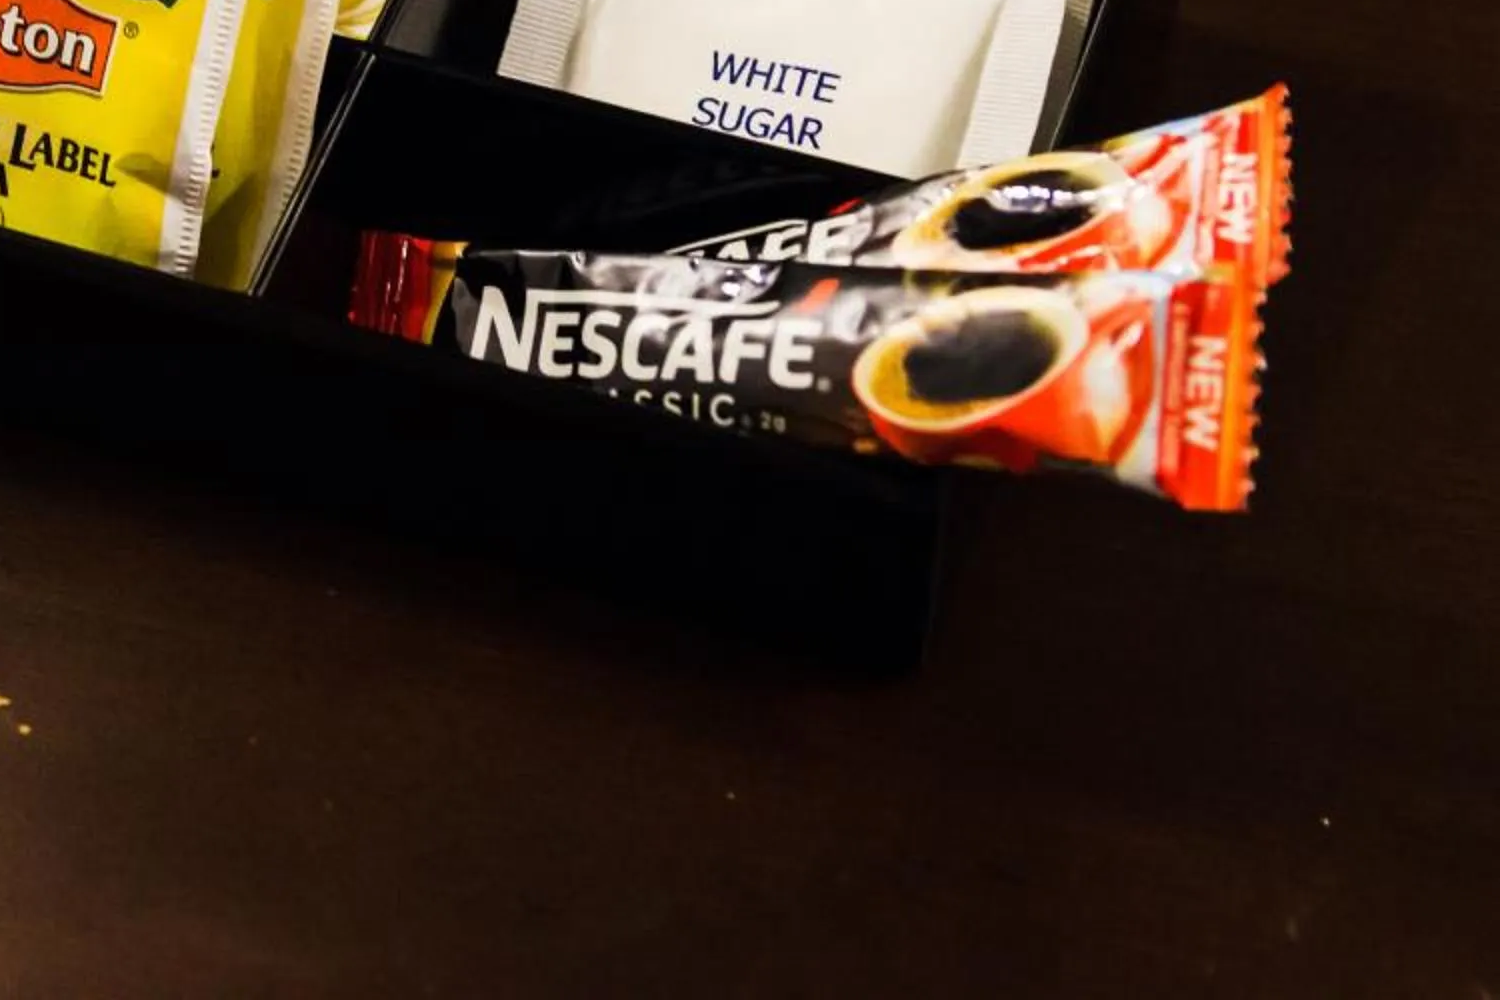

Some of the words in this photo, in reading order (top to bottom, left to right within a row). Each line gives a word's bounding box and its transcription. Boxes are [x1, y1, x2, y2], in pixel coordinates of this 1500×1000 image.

[711, 49, 842, 104] WHITE
[8, 122, 117, 188] LABEL
[691, 96, 823, 150] SUGAR
[1216, 152, 1258, 244] NEW
[1182, 334, 1229, 452] NEW
